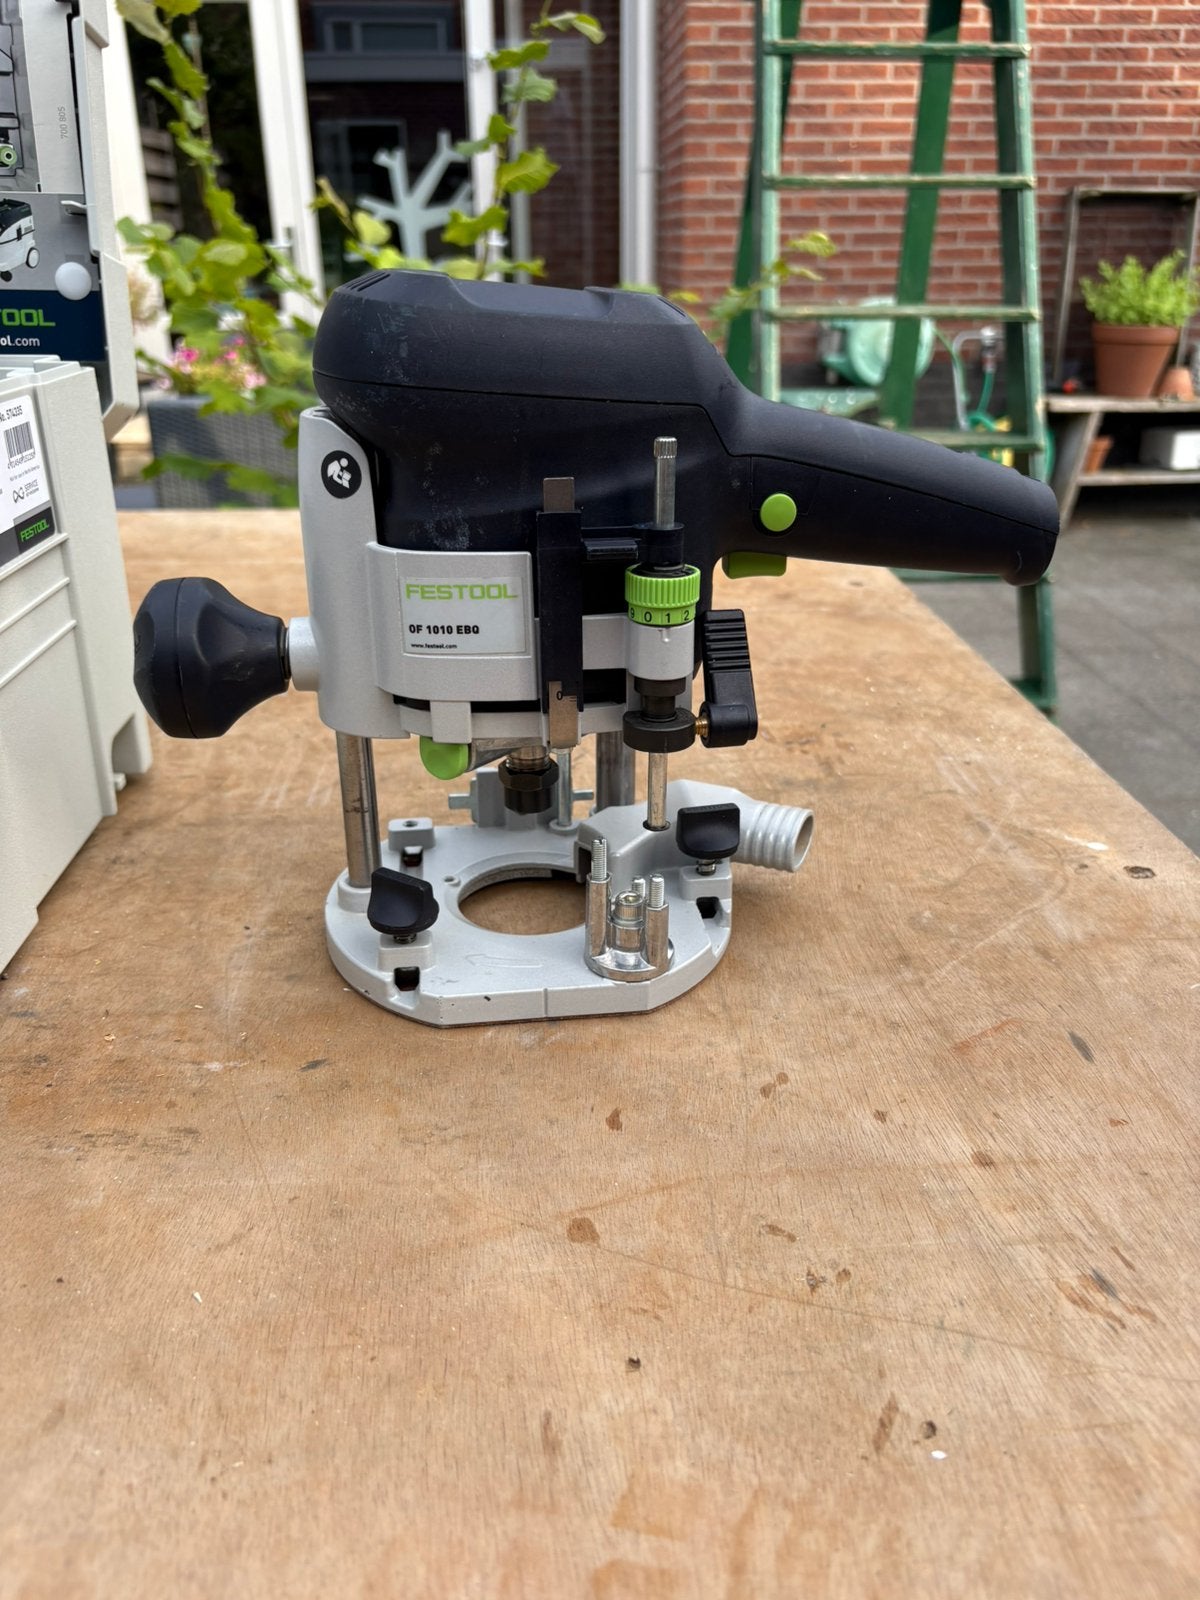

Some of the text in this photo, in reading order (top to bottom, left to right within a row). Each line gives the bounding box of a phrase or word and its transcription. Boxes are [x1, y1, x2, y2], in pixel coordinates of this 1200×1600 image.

[0, 309, 56, 326] OOL
[20, 519, 50, 542] FESTOOL
[405, 583, 519, 600] FESTOOL
[630, 607, 690, 623] 9 0 1 2
[409, 624, 480, 635] OF 1010 EBQ
